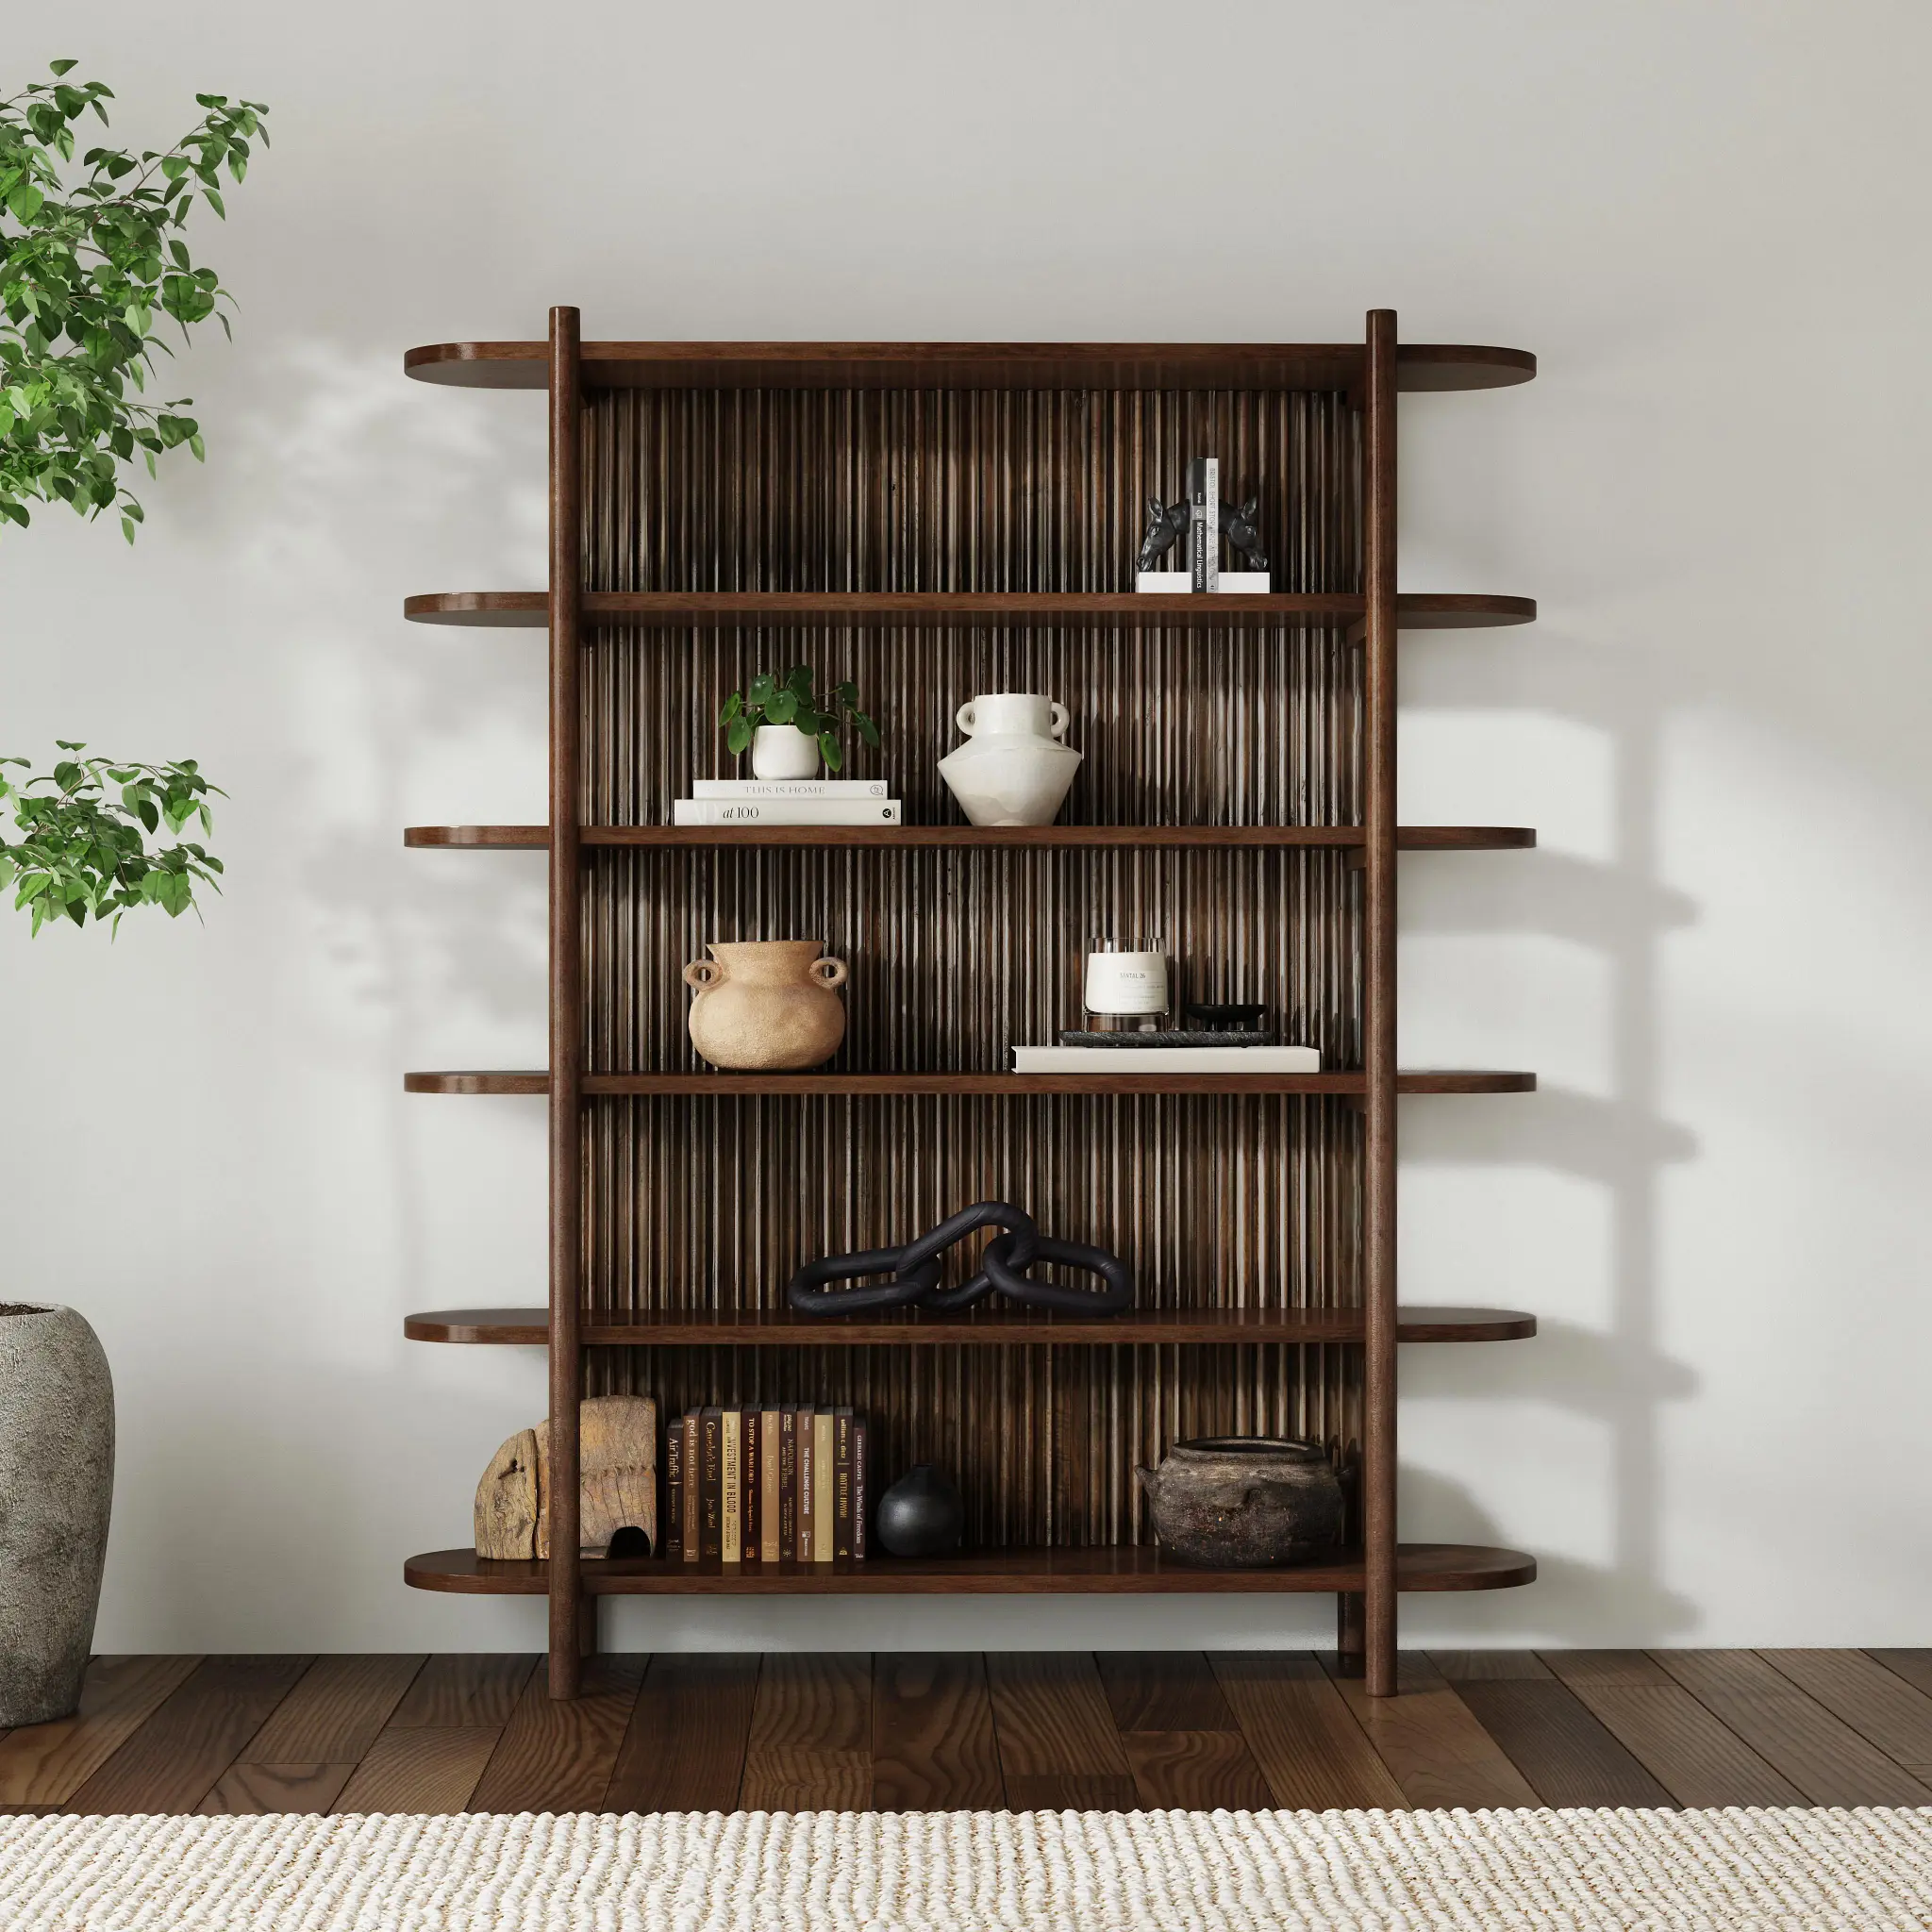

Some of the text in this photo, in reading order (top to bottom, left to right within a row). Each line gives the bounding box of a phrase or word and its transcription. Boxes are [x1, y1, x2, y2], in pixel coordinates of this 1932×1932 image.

[1195, 559, 1204, 589] Linguistics
[789, 786, 825, 794] HOME
[723, 808, 733, 819] at
[737, 807, 759, 819] 100
[687, 1419, 698, 1437] god
[748, 1417, 755, 1427] TO
[668, 1438, 678, 1451] Air
[689, 1439, 698, 1447] is
[706, 1422, 717, 1482] Camelot's End
[668, 1451, 678, 1478] Traffic
[689, 1449, 697, 1466] not
[726, 1437, 737, 1480] INVESTMENT
[689, 1468, 698, 1489] here
[840, 1473, 848, 1496] BATTLE
[726, 1491, 737, 1514] BLOOD
